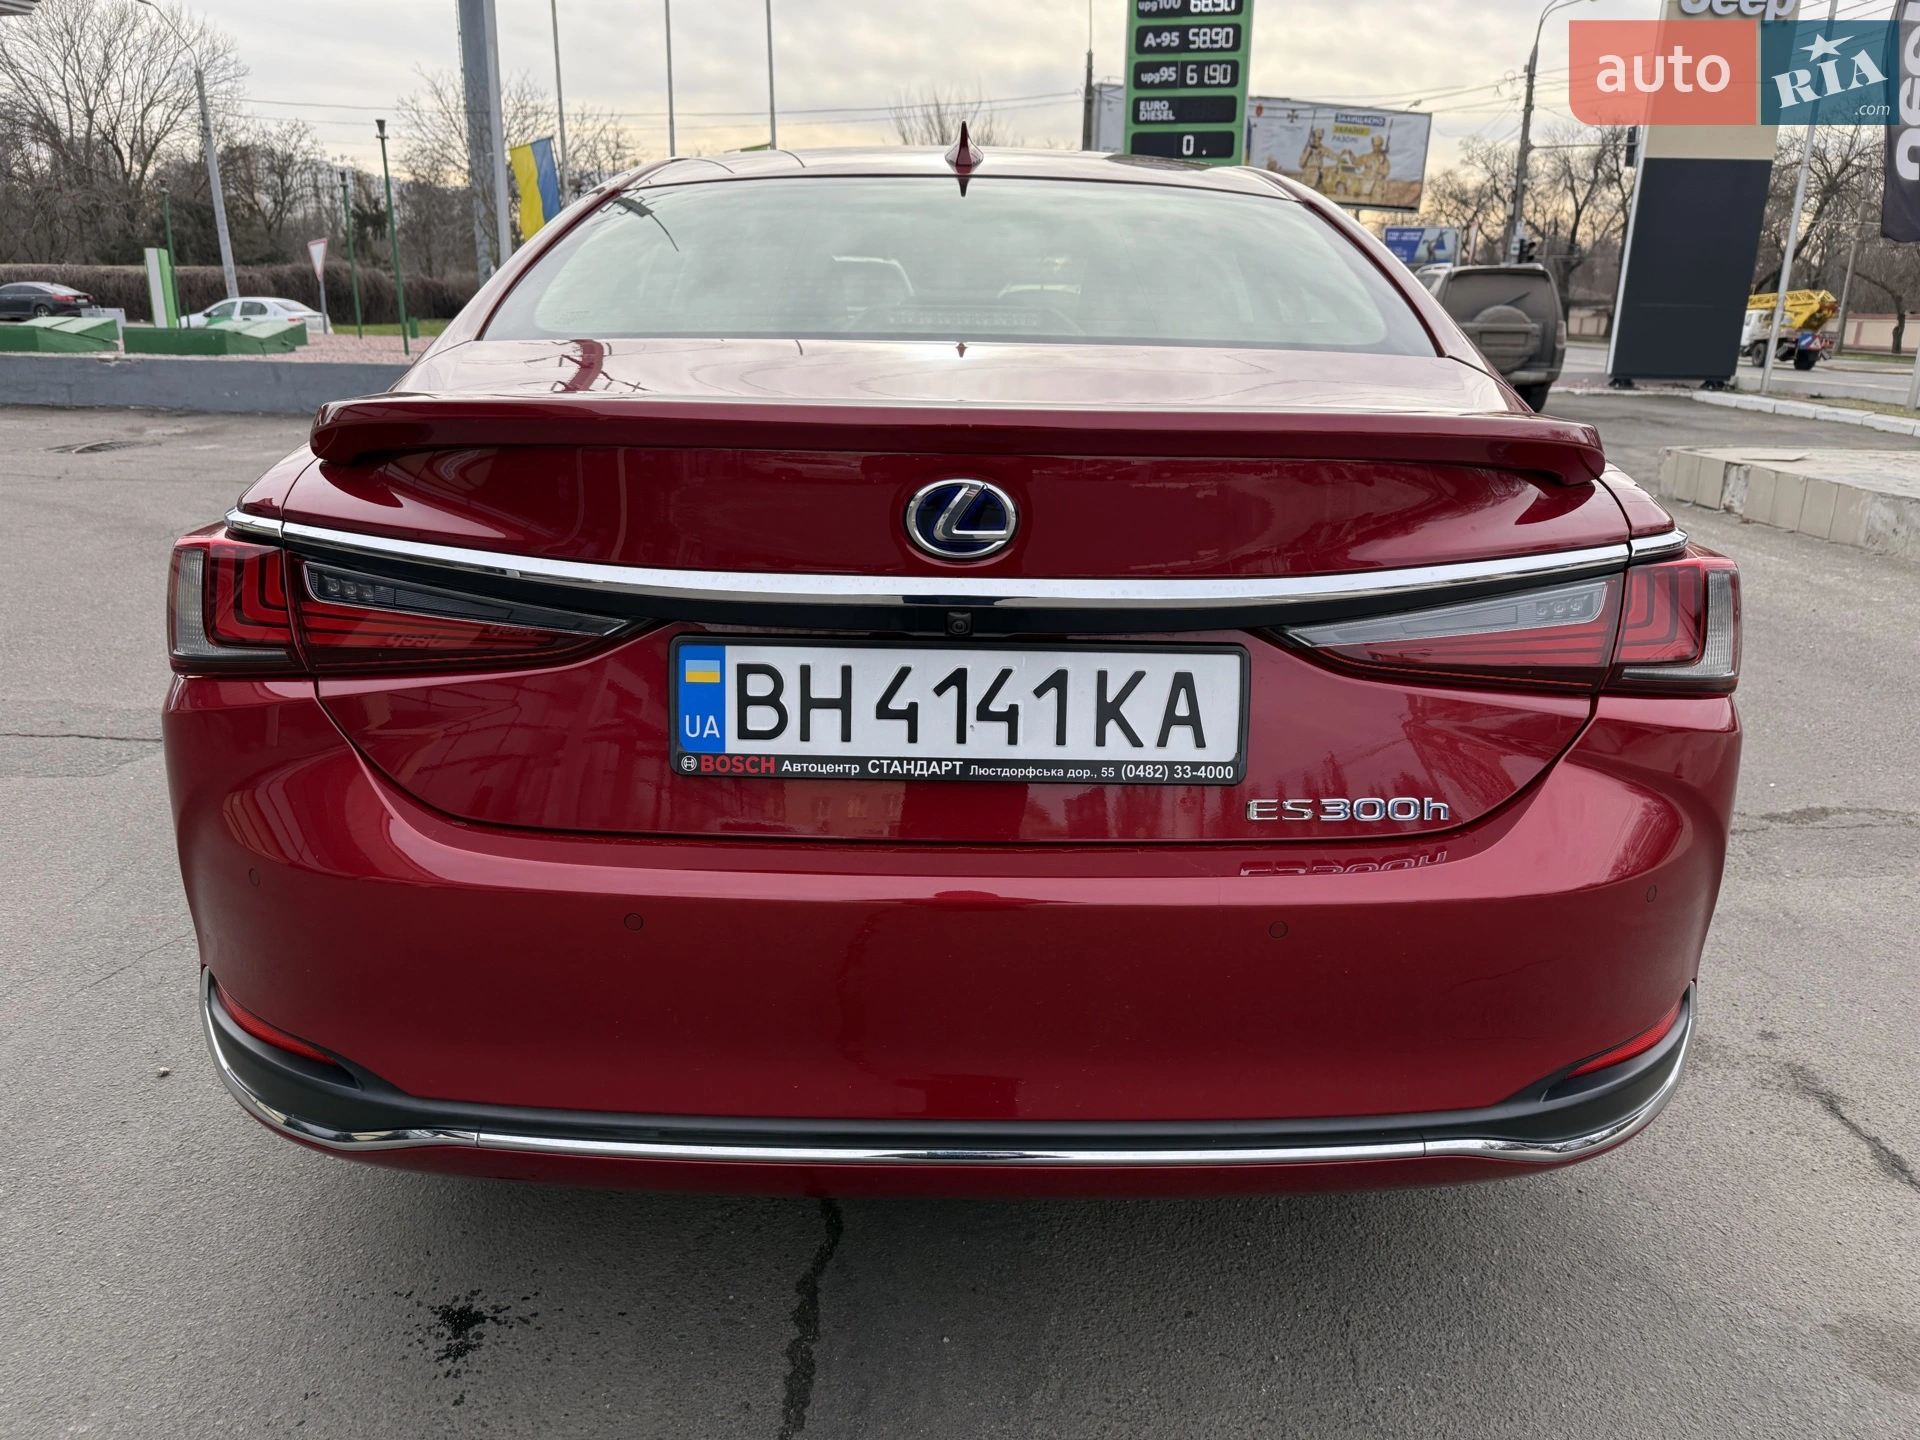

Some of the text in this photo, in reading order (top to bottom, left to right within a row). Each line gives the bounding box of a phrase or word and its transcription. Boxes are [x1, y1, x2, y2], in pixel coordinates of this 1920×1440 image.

[1140, 66, 1177, 85] upg95
[1139, 100, 1169, 111] EURO
[1139, 110, 1175, 121] DIESEL
[737, 663, 1207, 748] BH 4141 KA
[685, 714, 720, 738] UA
[701, 755, 1234, 781] BOSCH Автоцентр СТАНДАРТ Люстдорфська дор., 55 (0482) 33-4000
